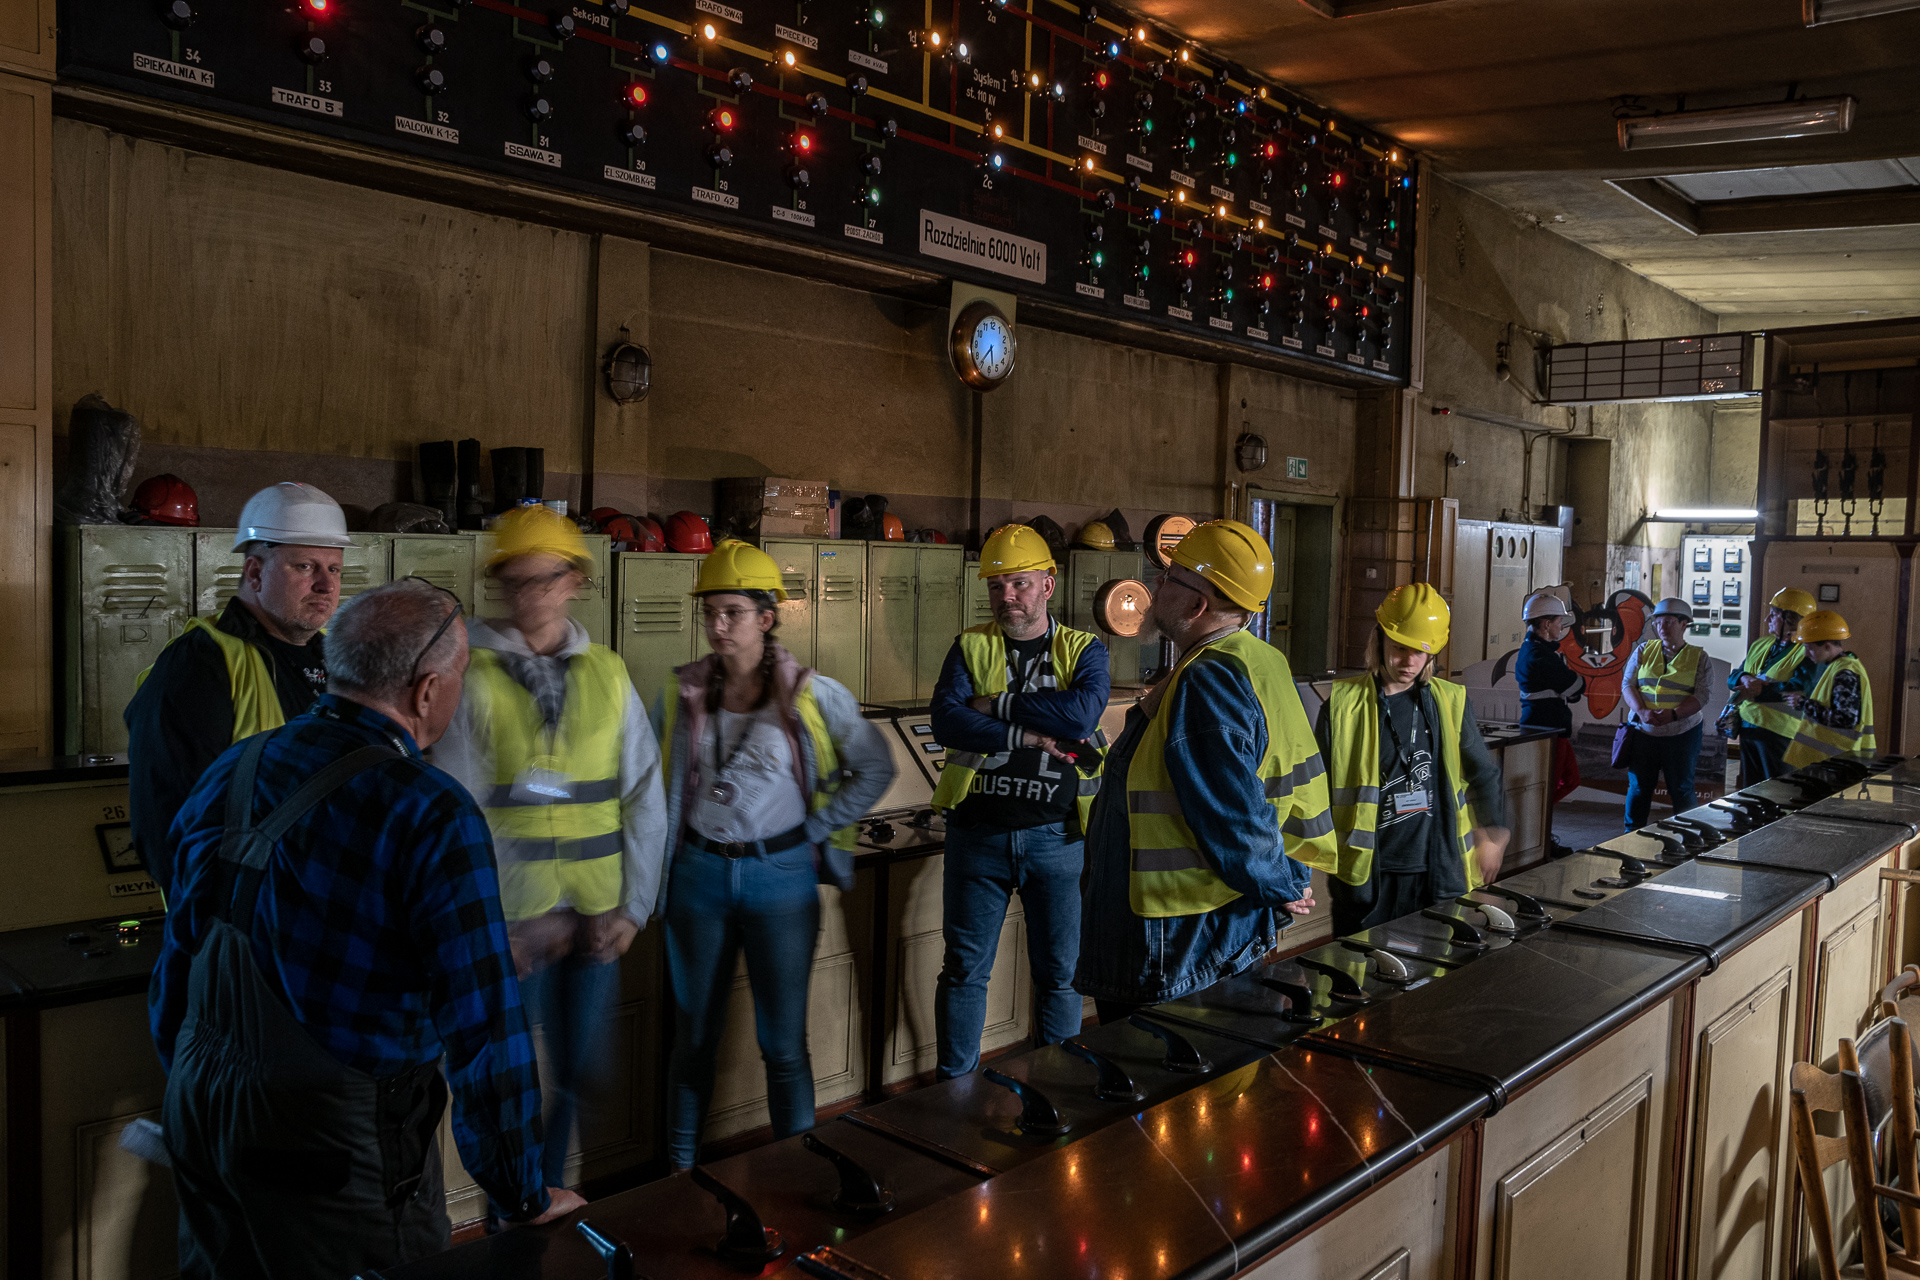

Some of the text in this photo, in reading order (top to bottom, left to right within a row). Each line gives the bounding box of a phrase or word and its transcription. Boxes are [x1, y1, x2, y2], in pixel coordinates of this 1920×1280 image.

[697, 0, 722, 14] TRAFO
[572, 6, 610, 28] Sekcja IV
[803, 15, 808, 24] 7
[988, 10, 996, 24] 2a
[186, 48, 201, 63] 34
[136, 56, 196, 81] SPIEKALNIA
[319, 80, 332, 94] 33
[973, 68, 1007, 92] System I
[278, 91, 335, 113] TRAFO 5
[978, 90, 987, 104] 110
[437, 110, 450, 124] 32
[539, 136, 550, 148] 31
[1080, 137, 1094, 149] TRAFO
[509, 145, 556, 164] SSAWA 2
[636, 159, 646, 171] 30
[719, 180, 730, 192] 29
[982, 174, 993, 190] 2c
[696, 188, 735, 208] TRAFO 42
[798, 200, 807, 210] 28
[868, 219, 877, 229] 27
[924, 219, 1040, 272] Rozdzielnia 6000 Volt
[983, 323, 988, 332] 11
[990, 321, 996, 330] 12
[977, 330, 983, 338] 10
[969, 774, 1060, 803] DUSTRY
[103, 806, 125, 820] 26
[115, 881, 156, 894] MŁYN
